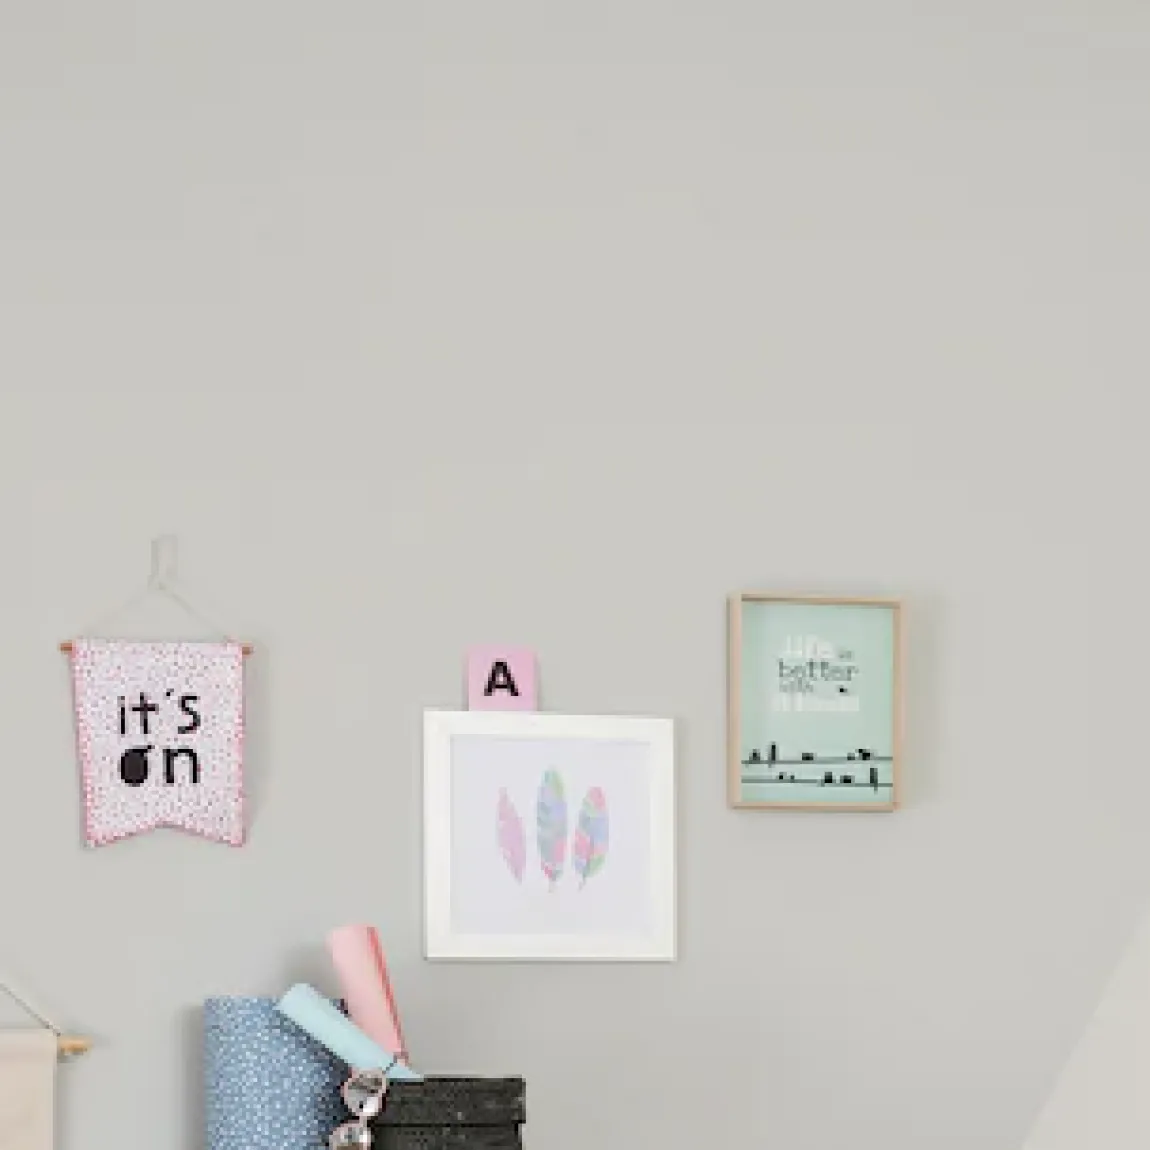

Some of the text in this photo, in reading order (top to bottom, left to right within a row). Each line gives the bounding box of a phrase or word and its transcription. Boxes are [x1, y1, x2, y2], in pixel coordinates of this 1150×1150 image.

[483, 659, 520, 697] A
[778, 658, 861, 682] better
[118, 744, 200, 787] on
